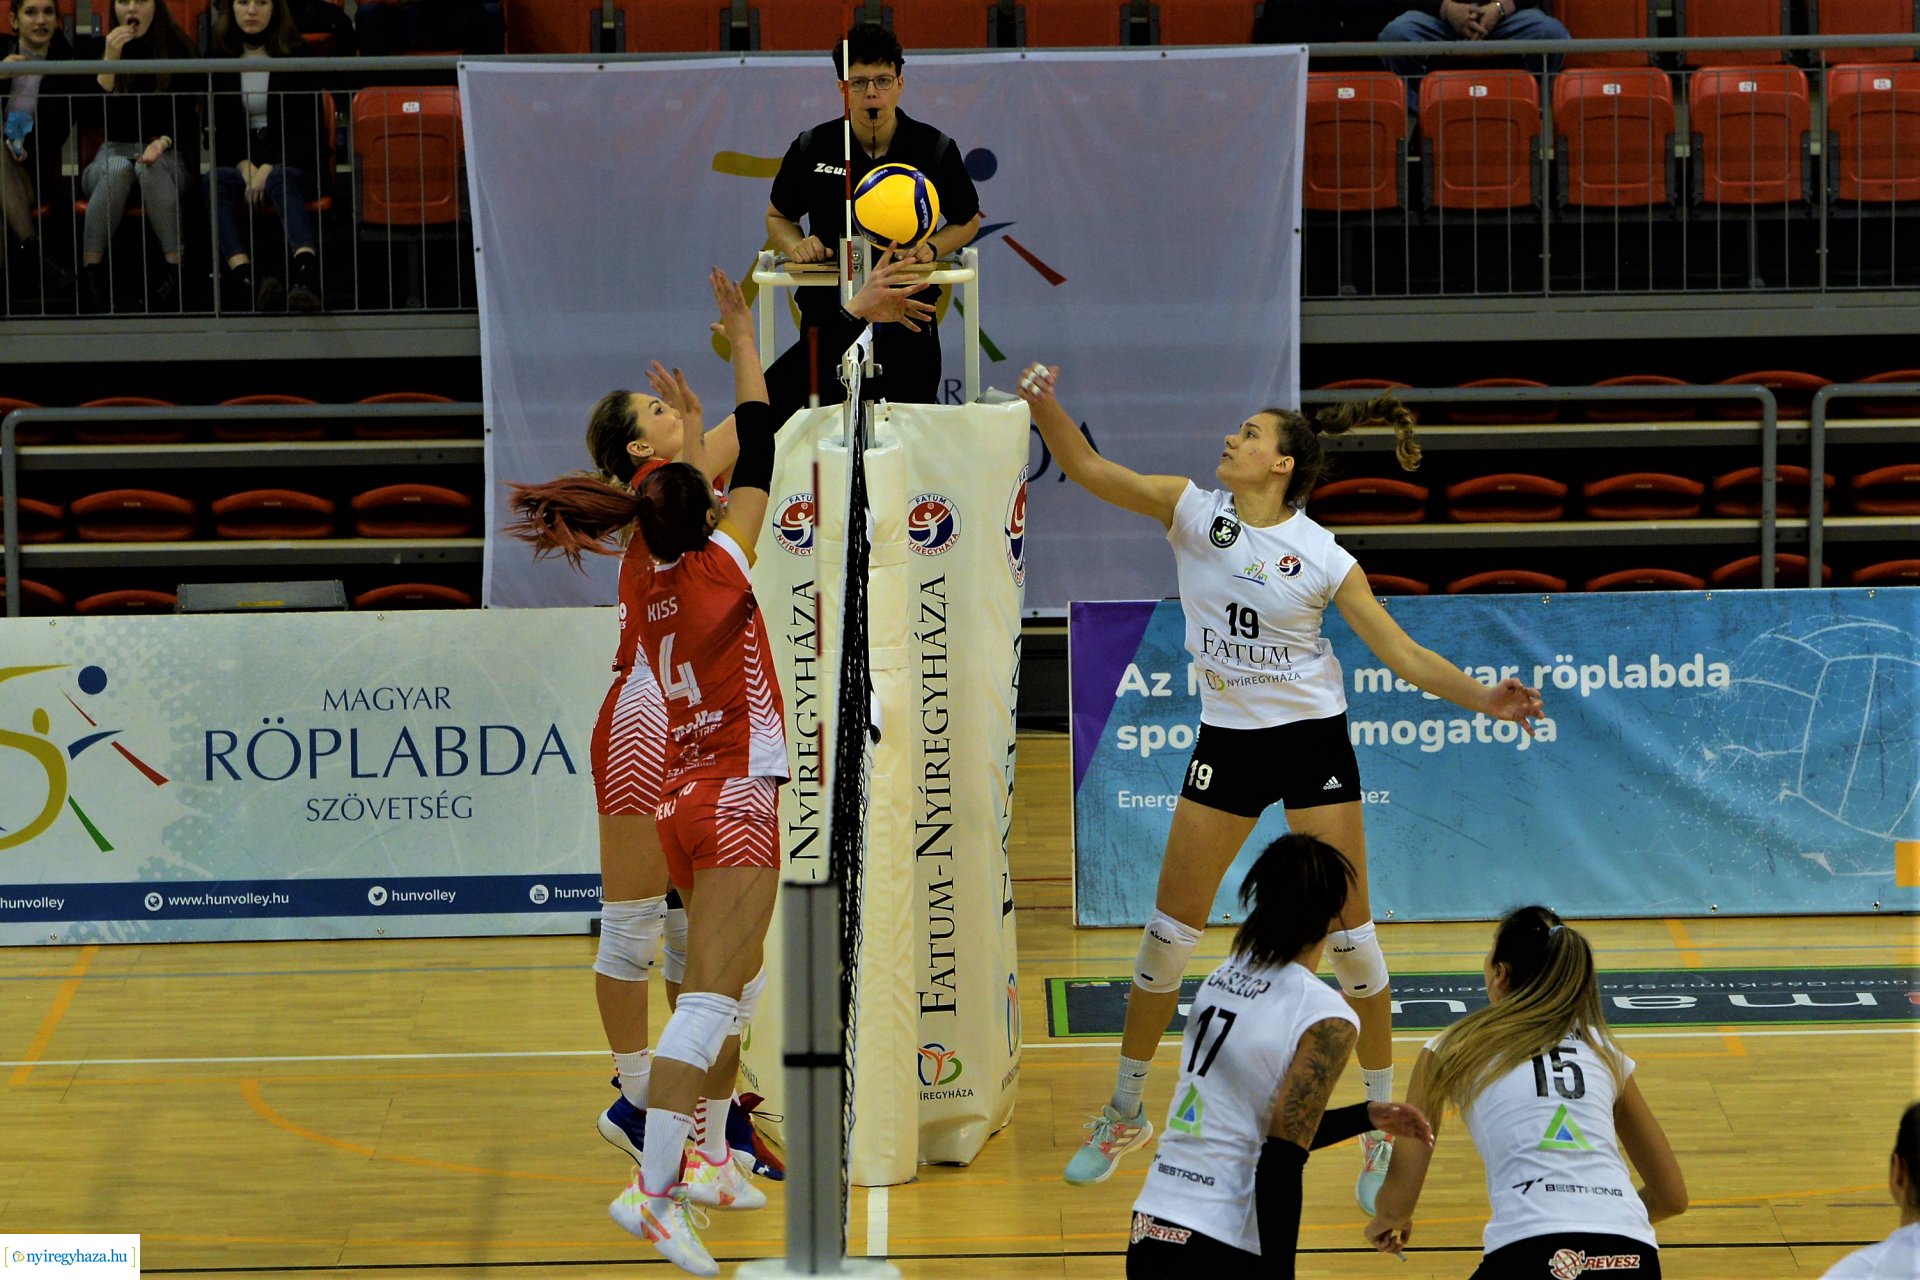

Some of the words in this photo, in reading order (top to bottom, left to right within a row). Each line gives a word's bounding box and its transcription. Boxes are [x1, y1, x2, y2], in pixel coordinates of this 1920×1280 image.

[788, 494, 814, 504] FATU
[915, 494, 947, 505] FATUM
[1222, 519, 1235, 527] CEV
[908, 532, 959, 555] YÍREGYHÁZA
[647, 596, 678, 622] KISS
[1225, 602, 1259, 639] 19
[1201, 627, 1292, 664] FATUM
[659, 632, 701, 708] 4
[1116, 663, 1172, 697] Az
[1533, 654, 1731, 696] röplabda
[1226, 672, 1302, 687] NYÍREGYHÁZA
[323, 687, 451, 712] MAGYAR
[205, 717, 577, 782] RÖPLABDA
[1116, 724, 1201, 758] spo
[1188, 760, 1213, 790] 19
[306, 790, 473, 822] SZÖVETSÉG
[1118, 791, 1178, 811] Energ
[0, 897, 65, 911] hunvolley
[168, 893, 290, 907] www.hunvolley.hu
[392, 887, 457, 903] hunvolley
[554, 886, 603, 898] hunvoll
[1187, 1005, 1237, 1078] 17
[1531, 1048, 1586, 1099] 15
[919, 1087, 974, 1101] ÍREGYHÁZA
[1158, 1163, 1215, 1187] BESTRONG
[1545, 1184, 1623, 1197] BESTRONG
